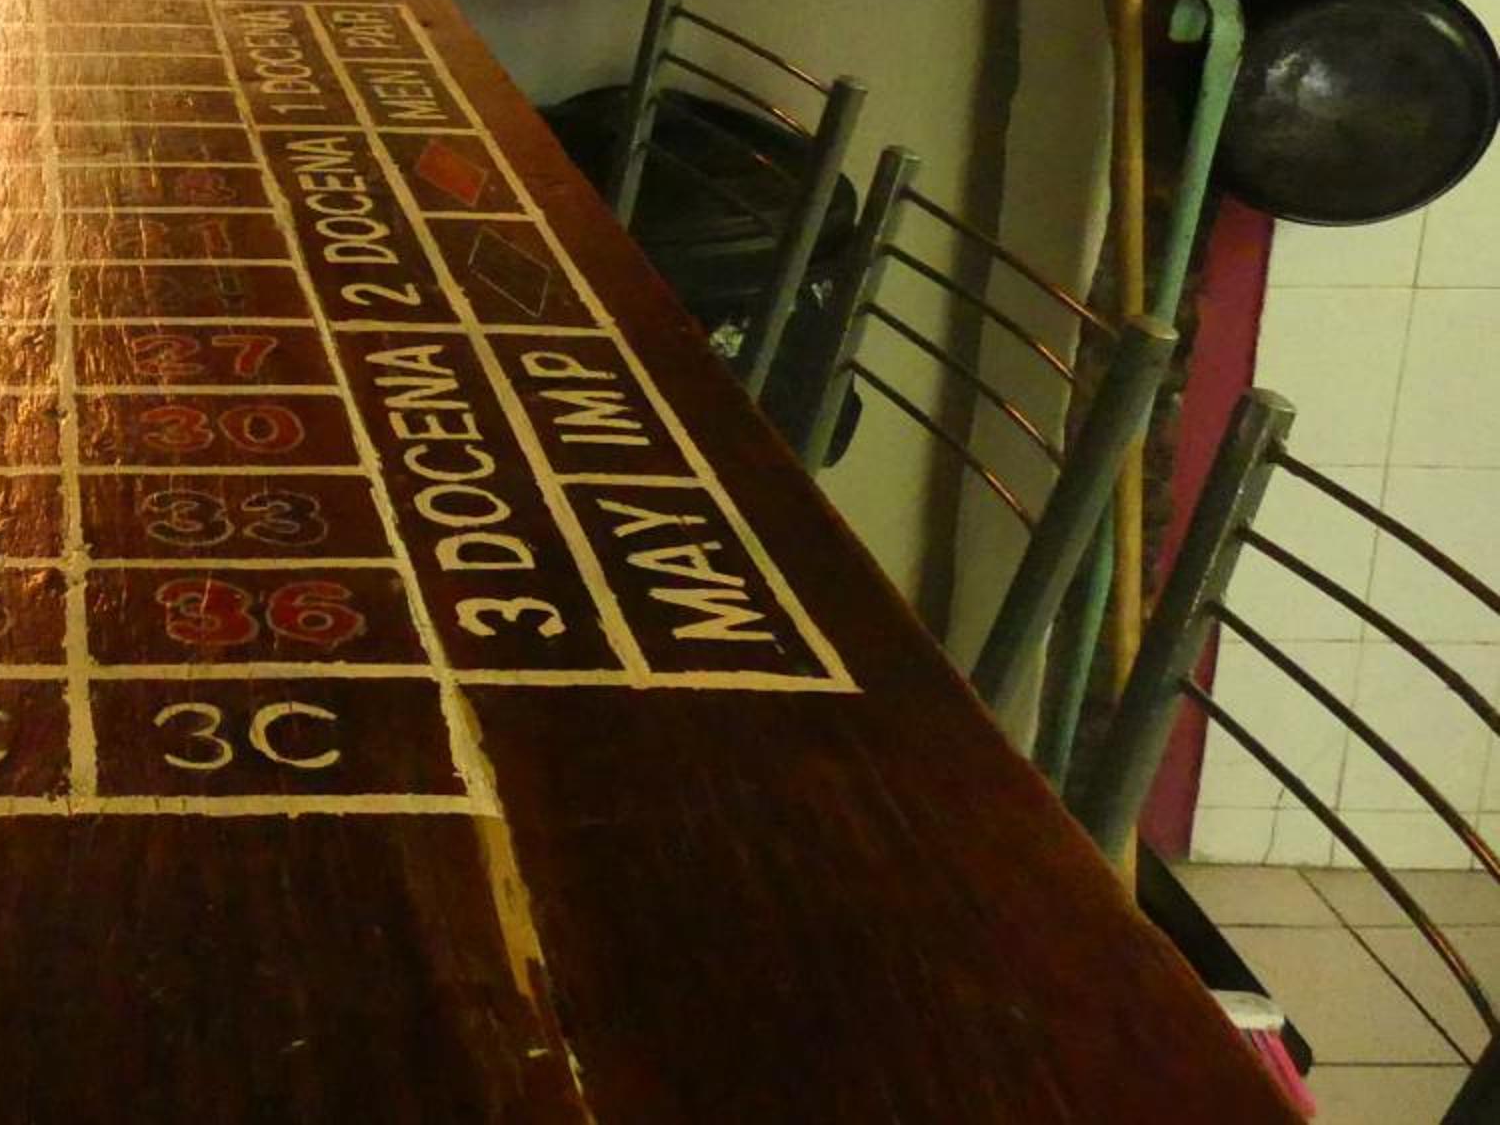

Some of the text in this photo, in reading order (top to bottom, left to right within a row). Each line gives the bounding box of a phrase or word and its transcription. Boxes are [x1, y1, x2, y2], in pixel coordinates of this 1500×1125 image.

[239, 9, 320, 94] DOCENA
[332, 10, 400, 49] PAR
[363, 68, 449, 120] MEN
[289, 135, 400, 265] DOCENA
[133, 334, 280, 377] 27
[139, 404, 305, 453] 30
[520, 350, 651, 446] IMP
[141, 488, 329, 547] 33
[365, 343, 567, 639] 3 DOCENA
[596, 497, 780, 642] MAY
[153, 577, 367, 649] 36
